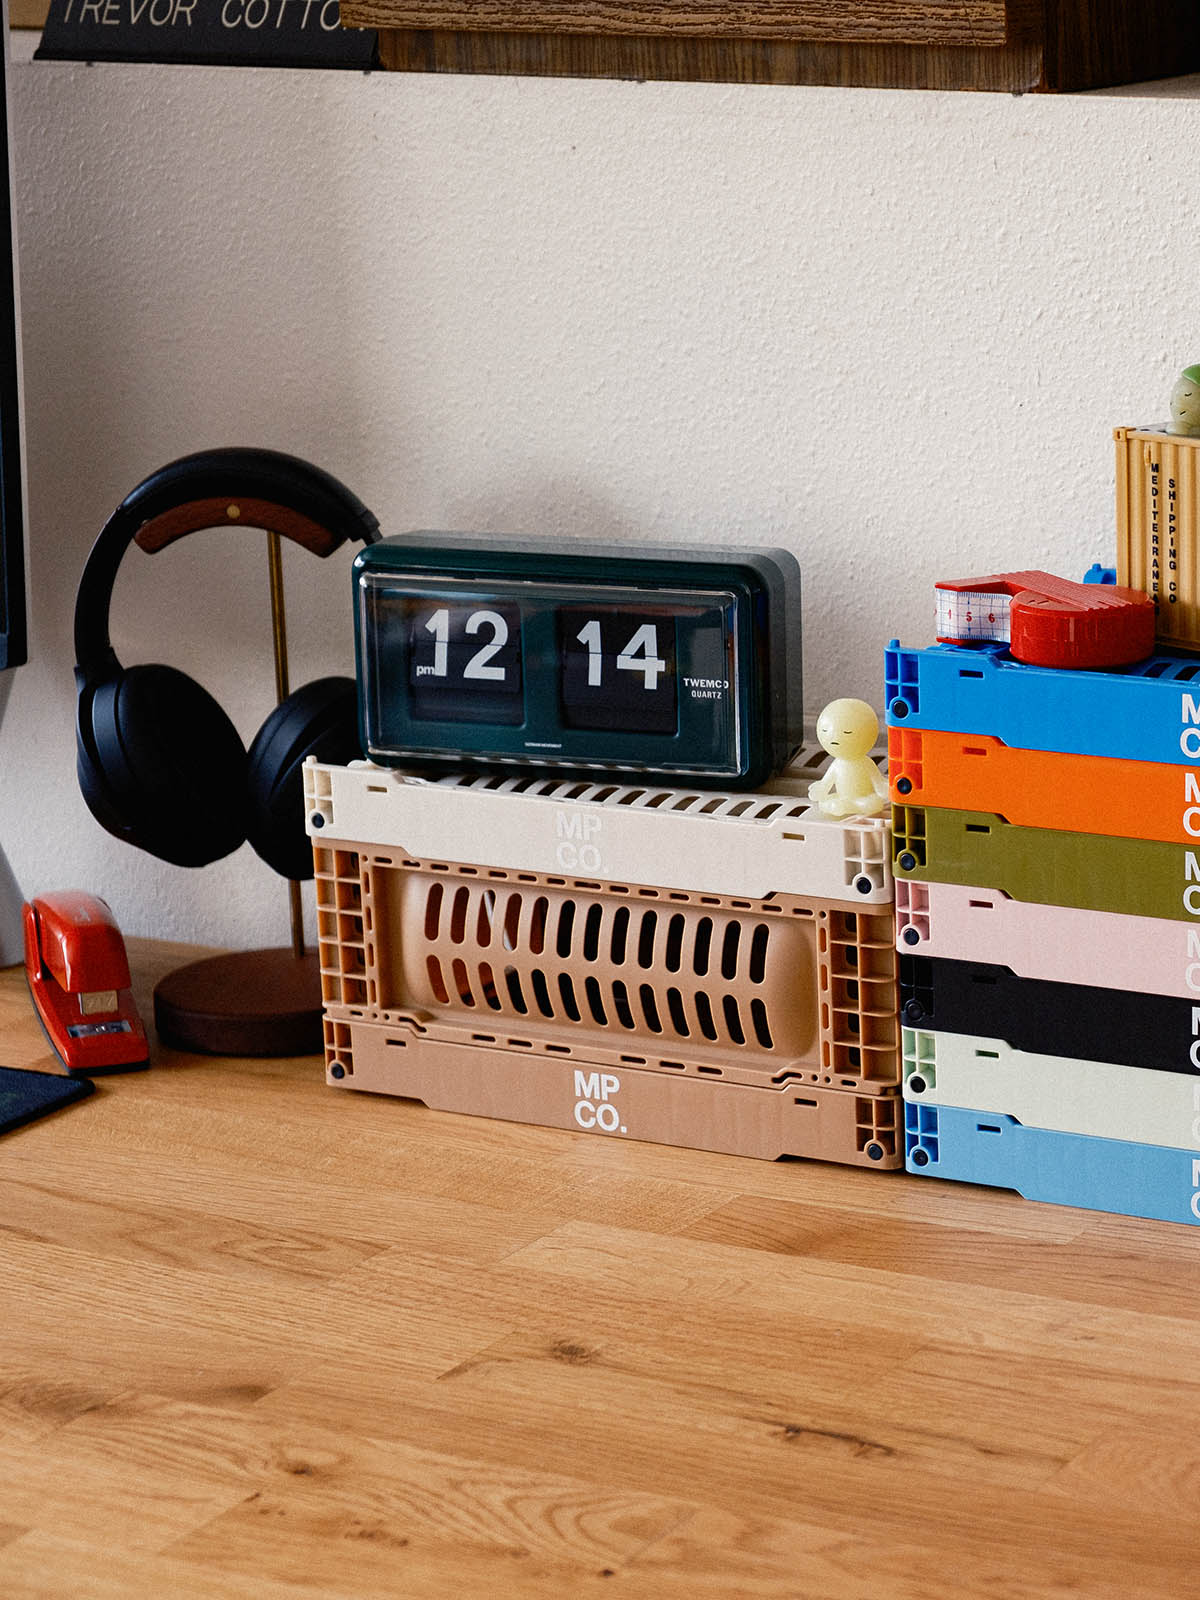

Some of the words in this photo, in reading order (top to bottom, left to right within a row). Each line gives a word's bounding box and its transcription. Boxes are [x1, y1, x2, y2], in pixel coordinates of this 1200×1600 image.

[64, 0, 197, 26] TREVOR
[221, 0, 365, 31] COTTO
[1168, 479, 1177, 570] SHIPPING
[1168, 582, 1177, 604] CO
[966, 611, 973, 623] 5
[988, 612, 996, 624] 6
[424, 609, 509, 681] 12
[576, 620, 666, 690] 14
[416, 665, 436, 677] pm
[683, 677, 730, 689] TWEMCO
[691, 689, 722, 700] QUARTZ
[574, 1069, 620, 1101] MP
[574, 1100, 628, 1134] CO.
